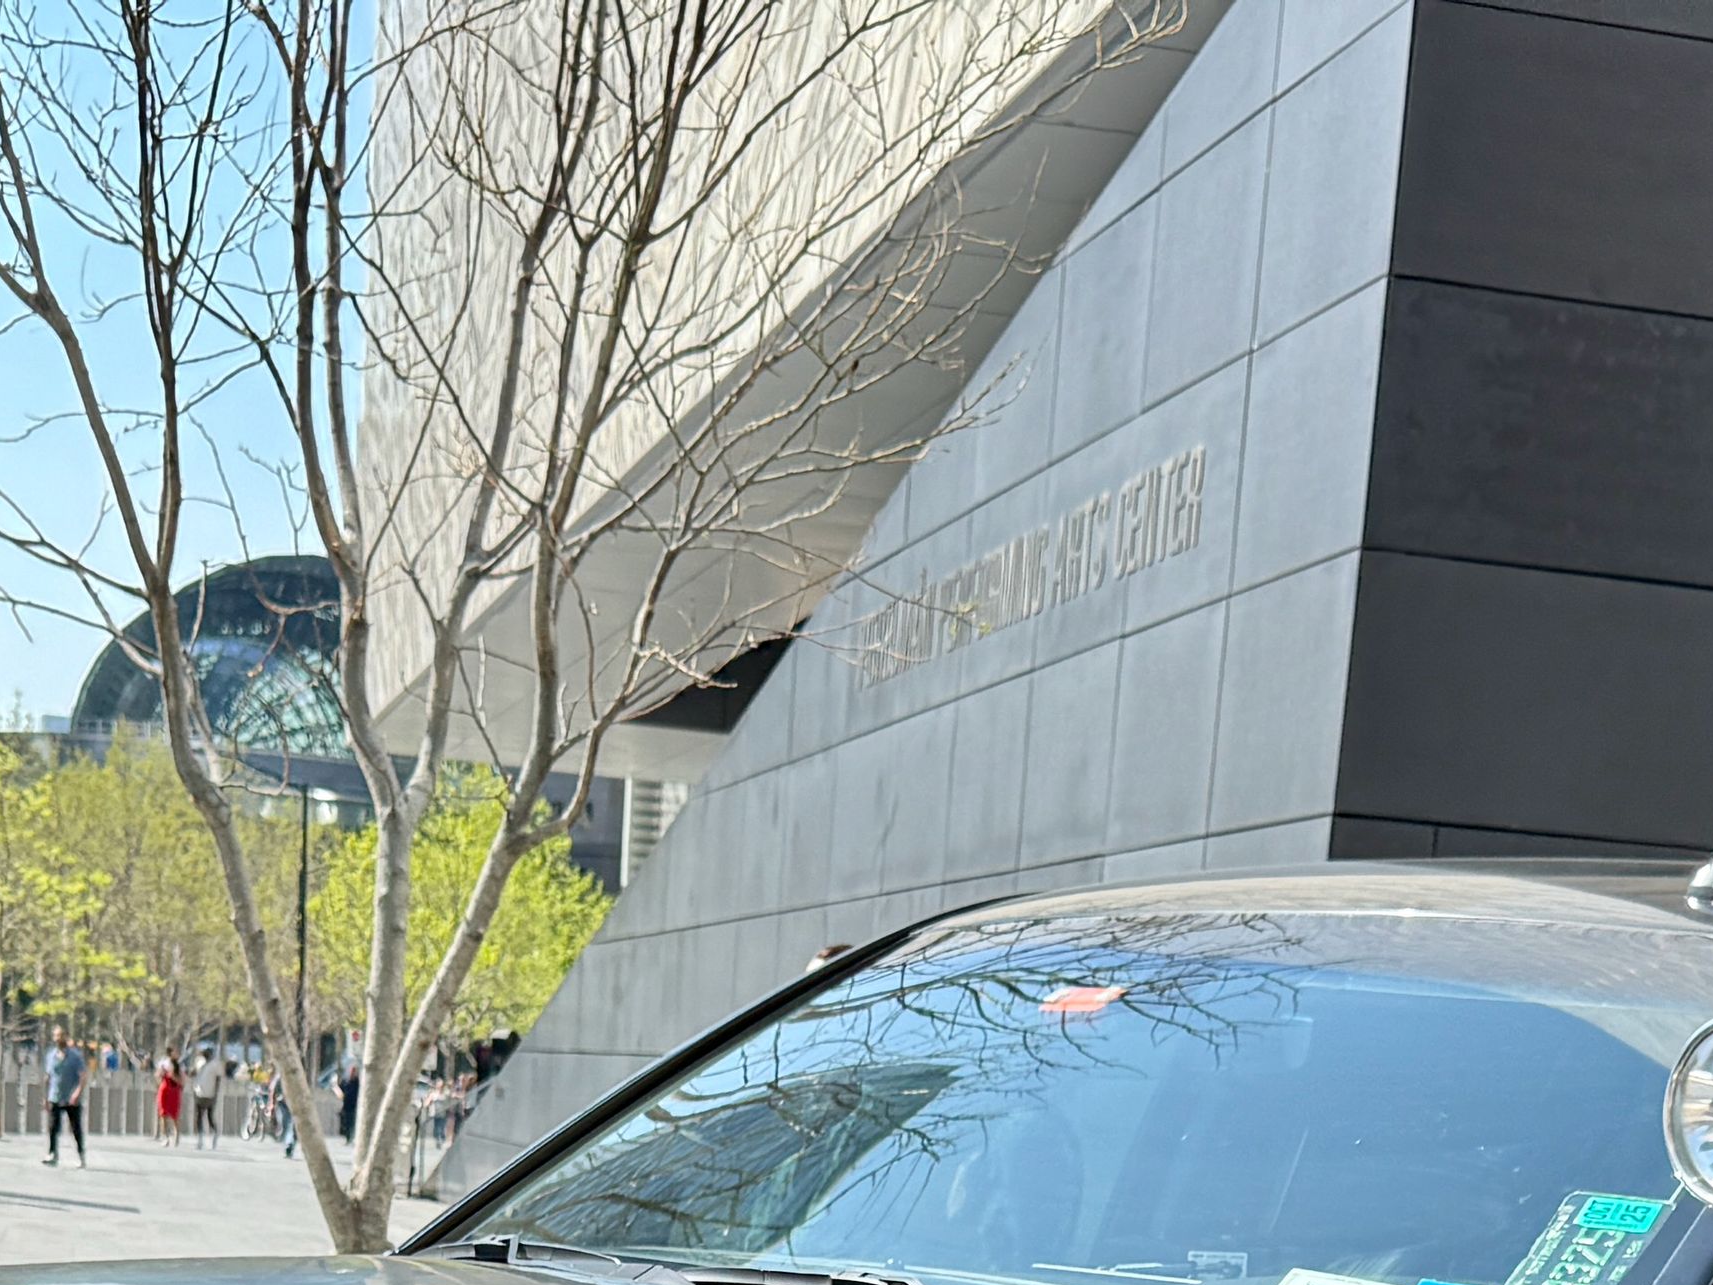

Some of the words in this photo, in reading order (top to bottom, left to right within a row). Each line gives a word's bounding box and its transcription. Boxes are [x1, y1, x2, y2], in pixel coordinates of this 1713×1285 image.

[1051, 490, 1111, 609] ARTS
[1114, 442, 1205, 580] CENTER
[1584, 1200, 1615, 1221] OCT
[1621, 1204, 1652, 1223] 25
